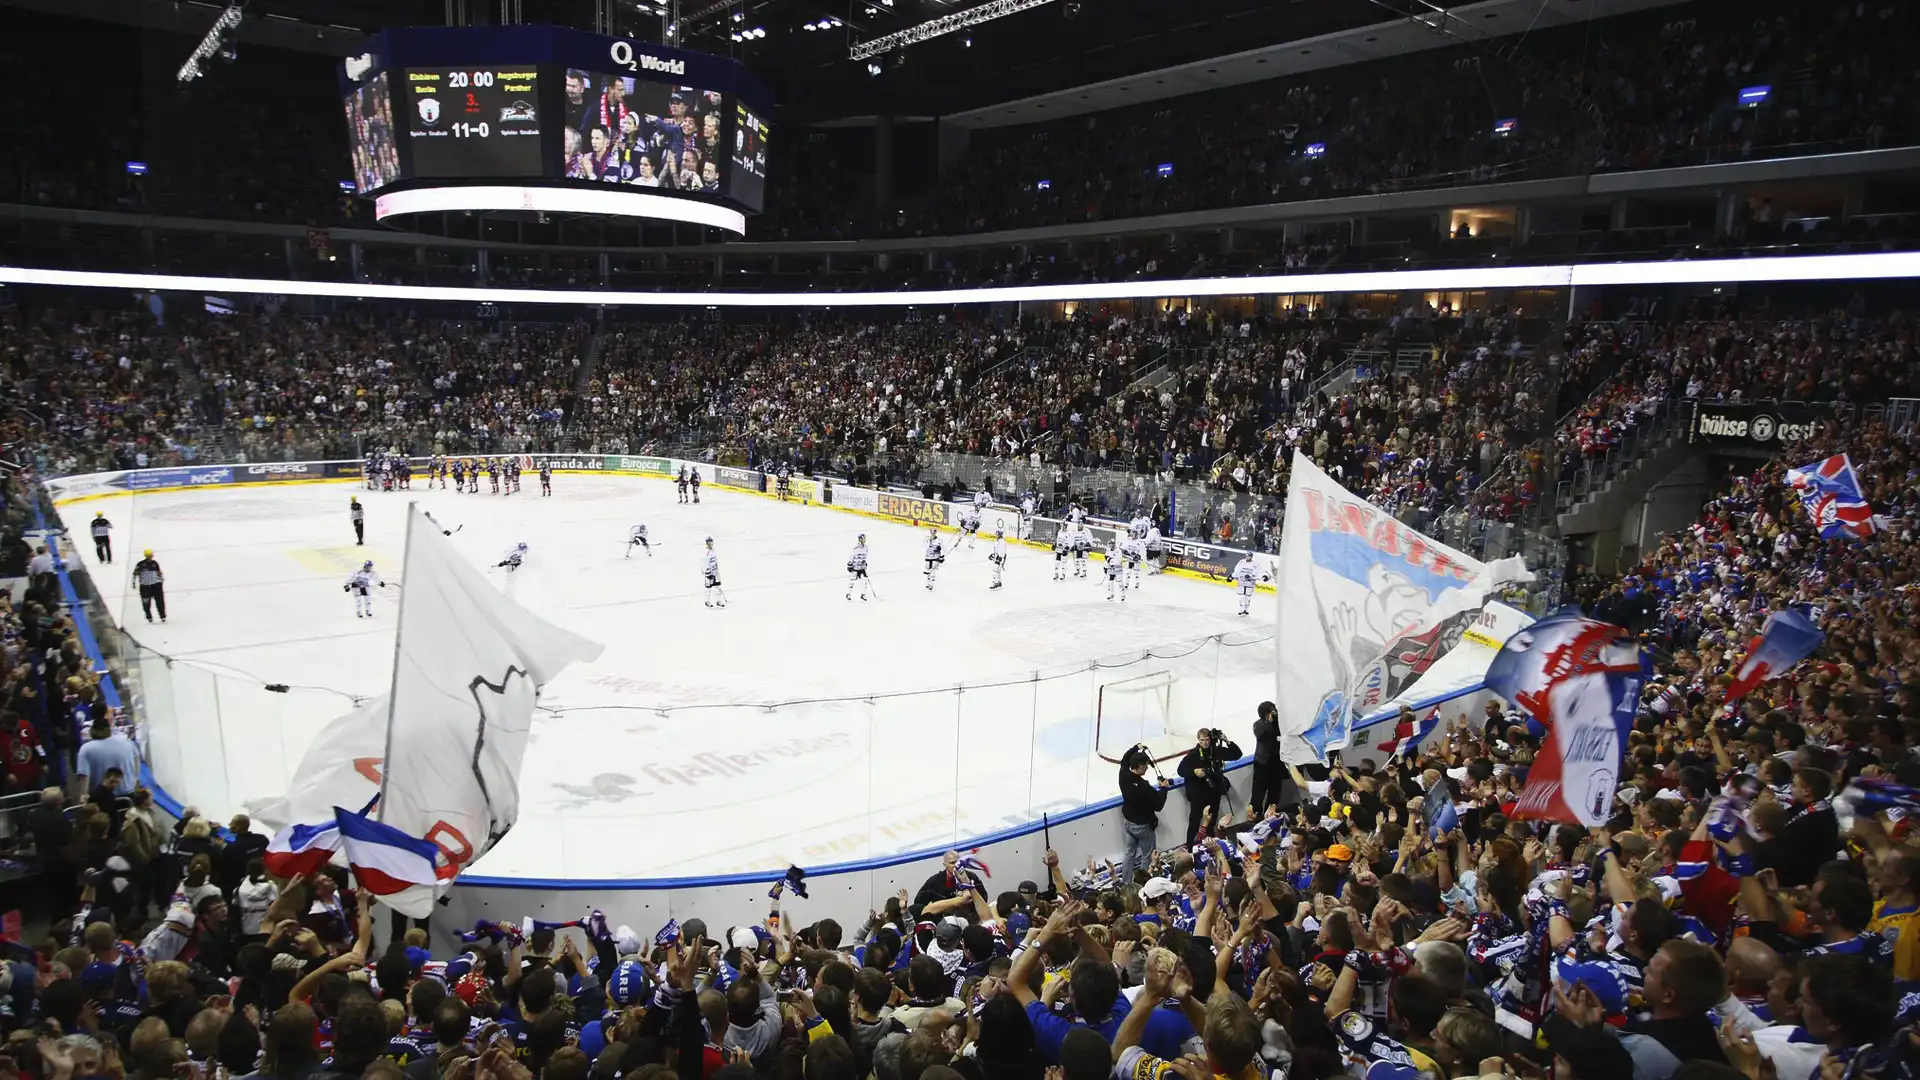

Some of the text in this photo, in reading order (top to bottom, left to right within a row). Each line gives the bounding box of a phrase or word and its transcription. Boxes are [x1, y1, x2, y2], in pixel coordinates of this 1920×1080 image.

[639, 54, 685, 75] World
[448, 71, 494, 88] 20:00
[451, 122, 490, 138] 11-0
[1700, 414, 1748, 436] böhse
[248, 464, 308, 474] GASAG
[536, 457, 603, 470] rmada.de
[620, 457, 661, 470] Europcar
[720, 468, 748, 480] GASAG
[1160, 541, 1211, 560] ASAG
[1196, 561, 1227, 574] Energie
